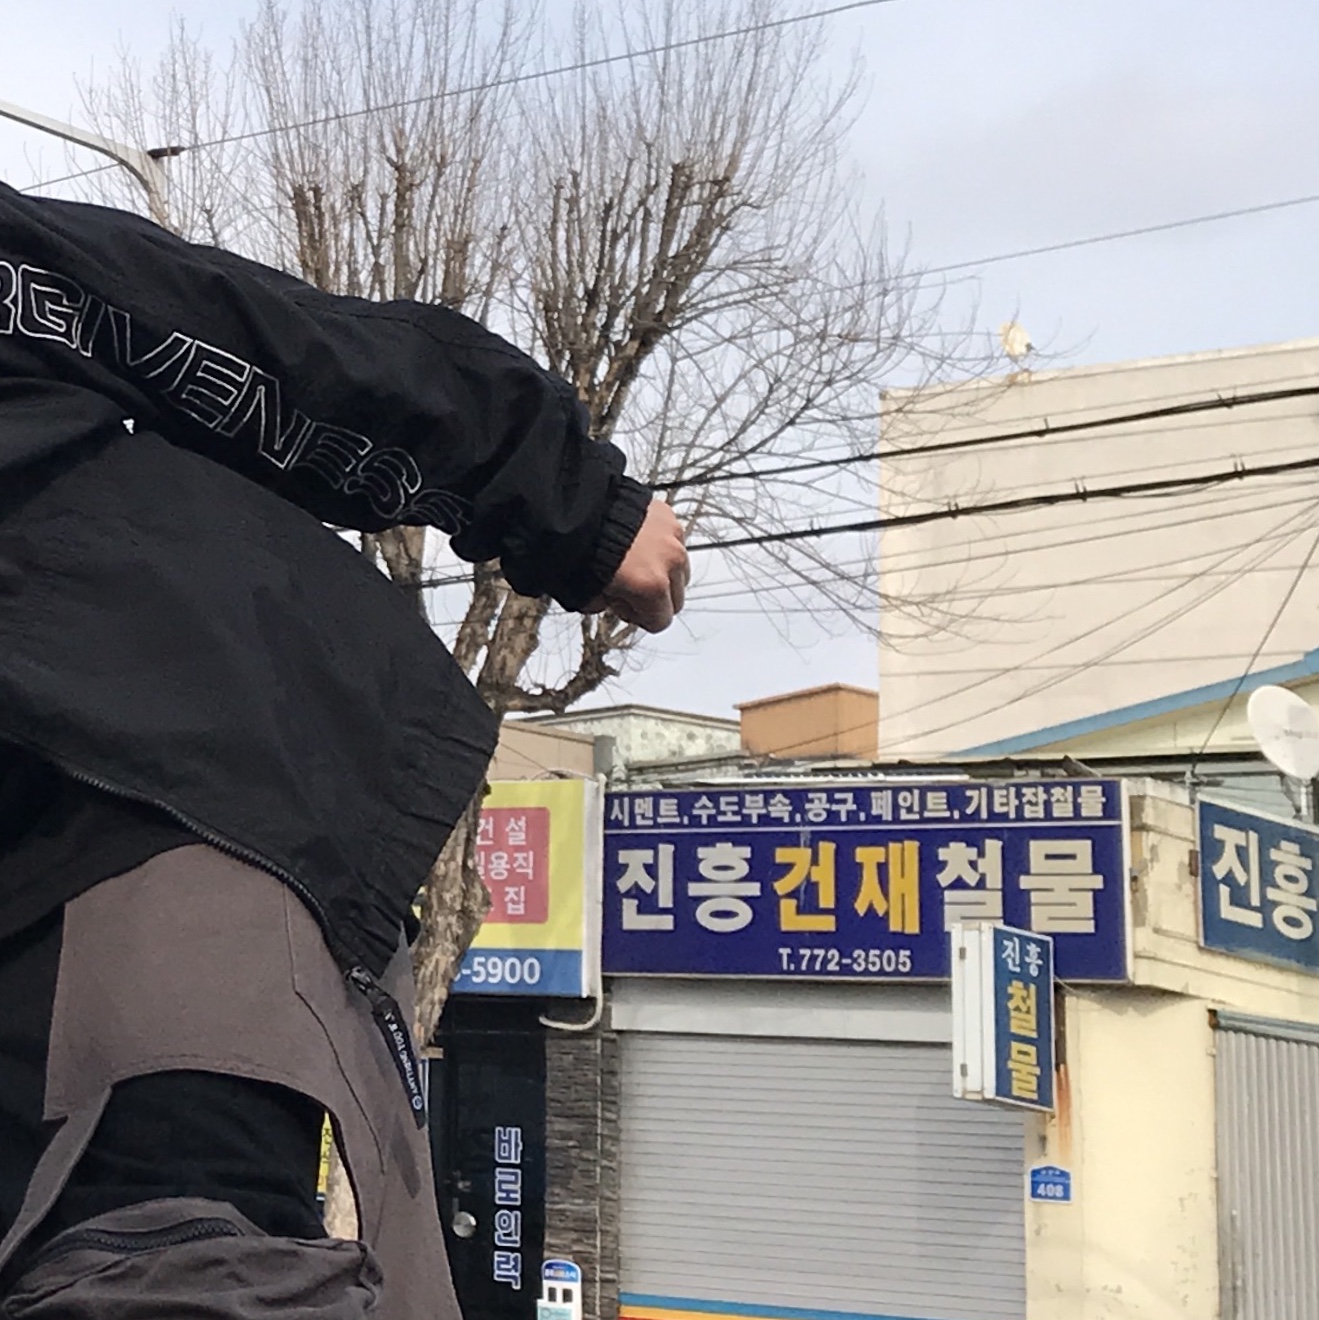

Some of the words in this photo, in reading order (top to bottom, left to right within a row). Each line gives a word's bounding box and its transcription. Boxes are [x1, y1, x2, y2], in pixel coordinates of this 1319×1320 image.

[1212, 823, 1318, 941] 진흥
[454, 956, 542, 985] -5900
[1001, 936, 1044, 979] 진흥
[1006, 980, 1041, 1101] 철물
[1036, 1183, 1065, 1198] 408
